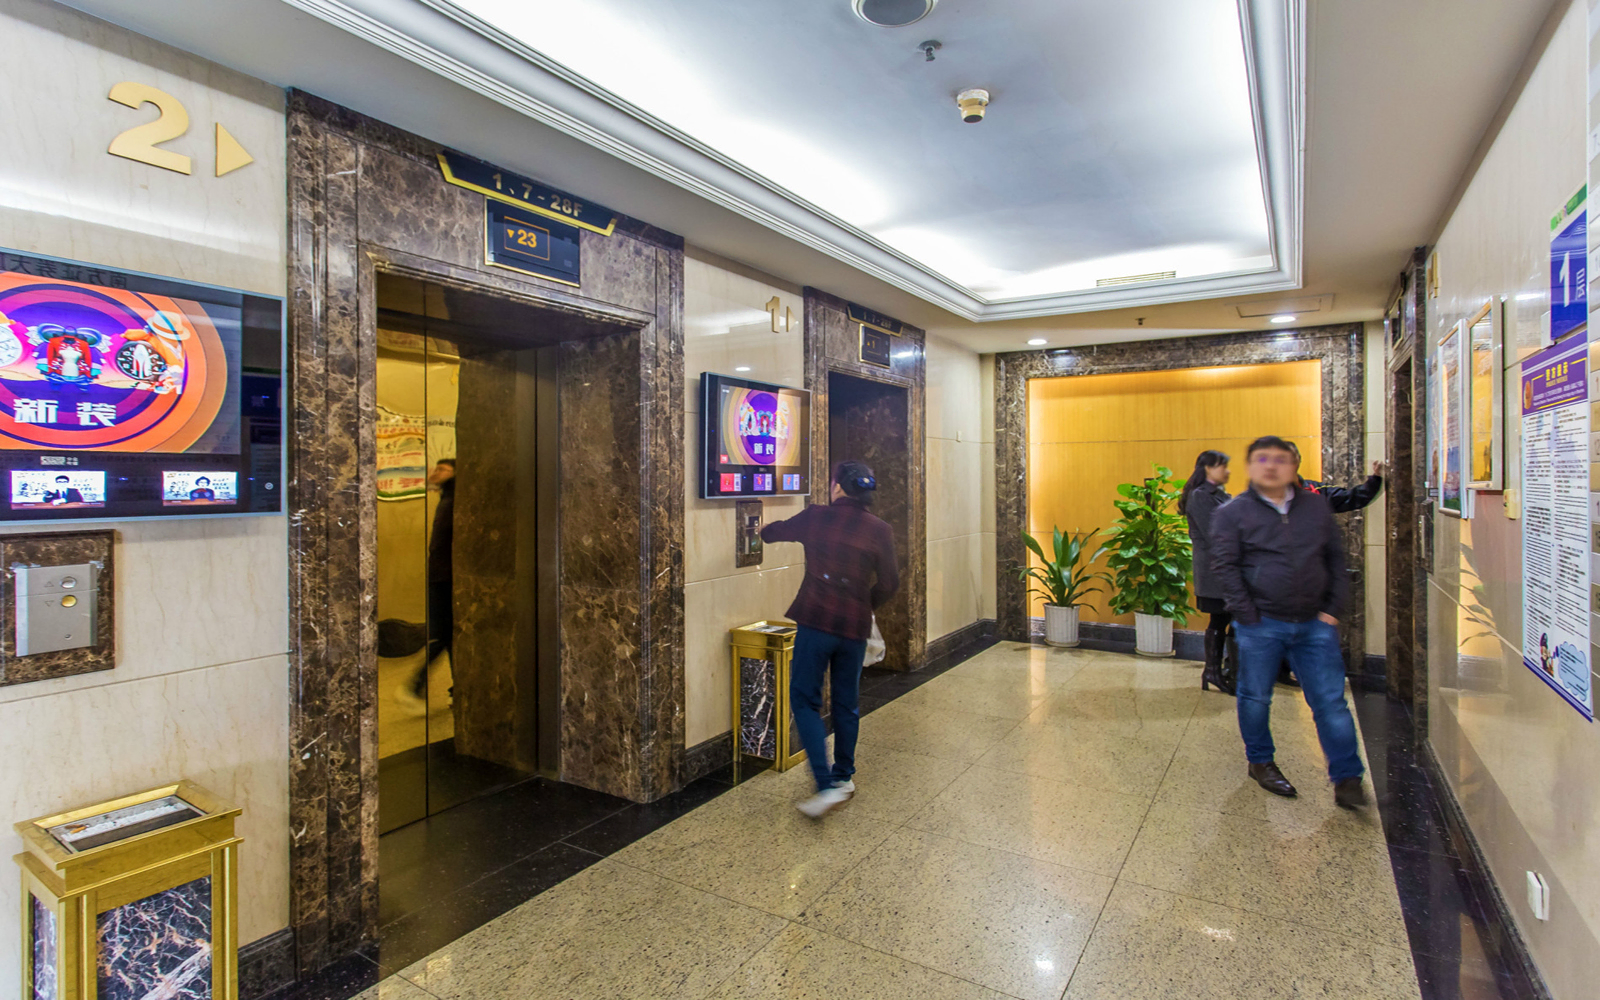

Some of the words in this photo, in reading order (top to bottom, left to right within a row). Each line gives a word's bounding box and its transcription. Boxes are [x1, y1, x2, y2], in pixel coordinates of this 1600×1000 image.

[107, 81, 192, 176] 2
[517, 229, 538, 248] 23
[766, 296, 780, 333] 1
[13, 398, 116, 427] 新装
